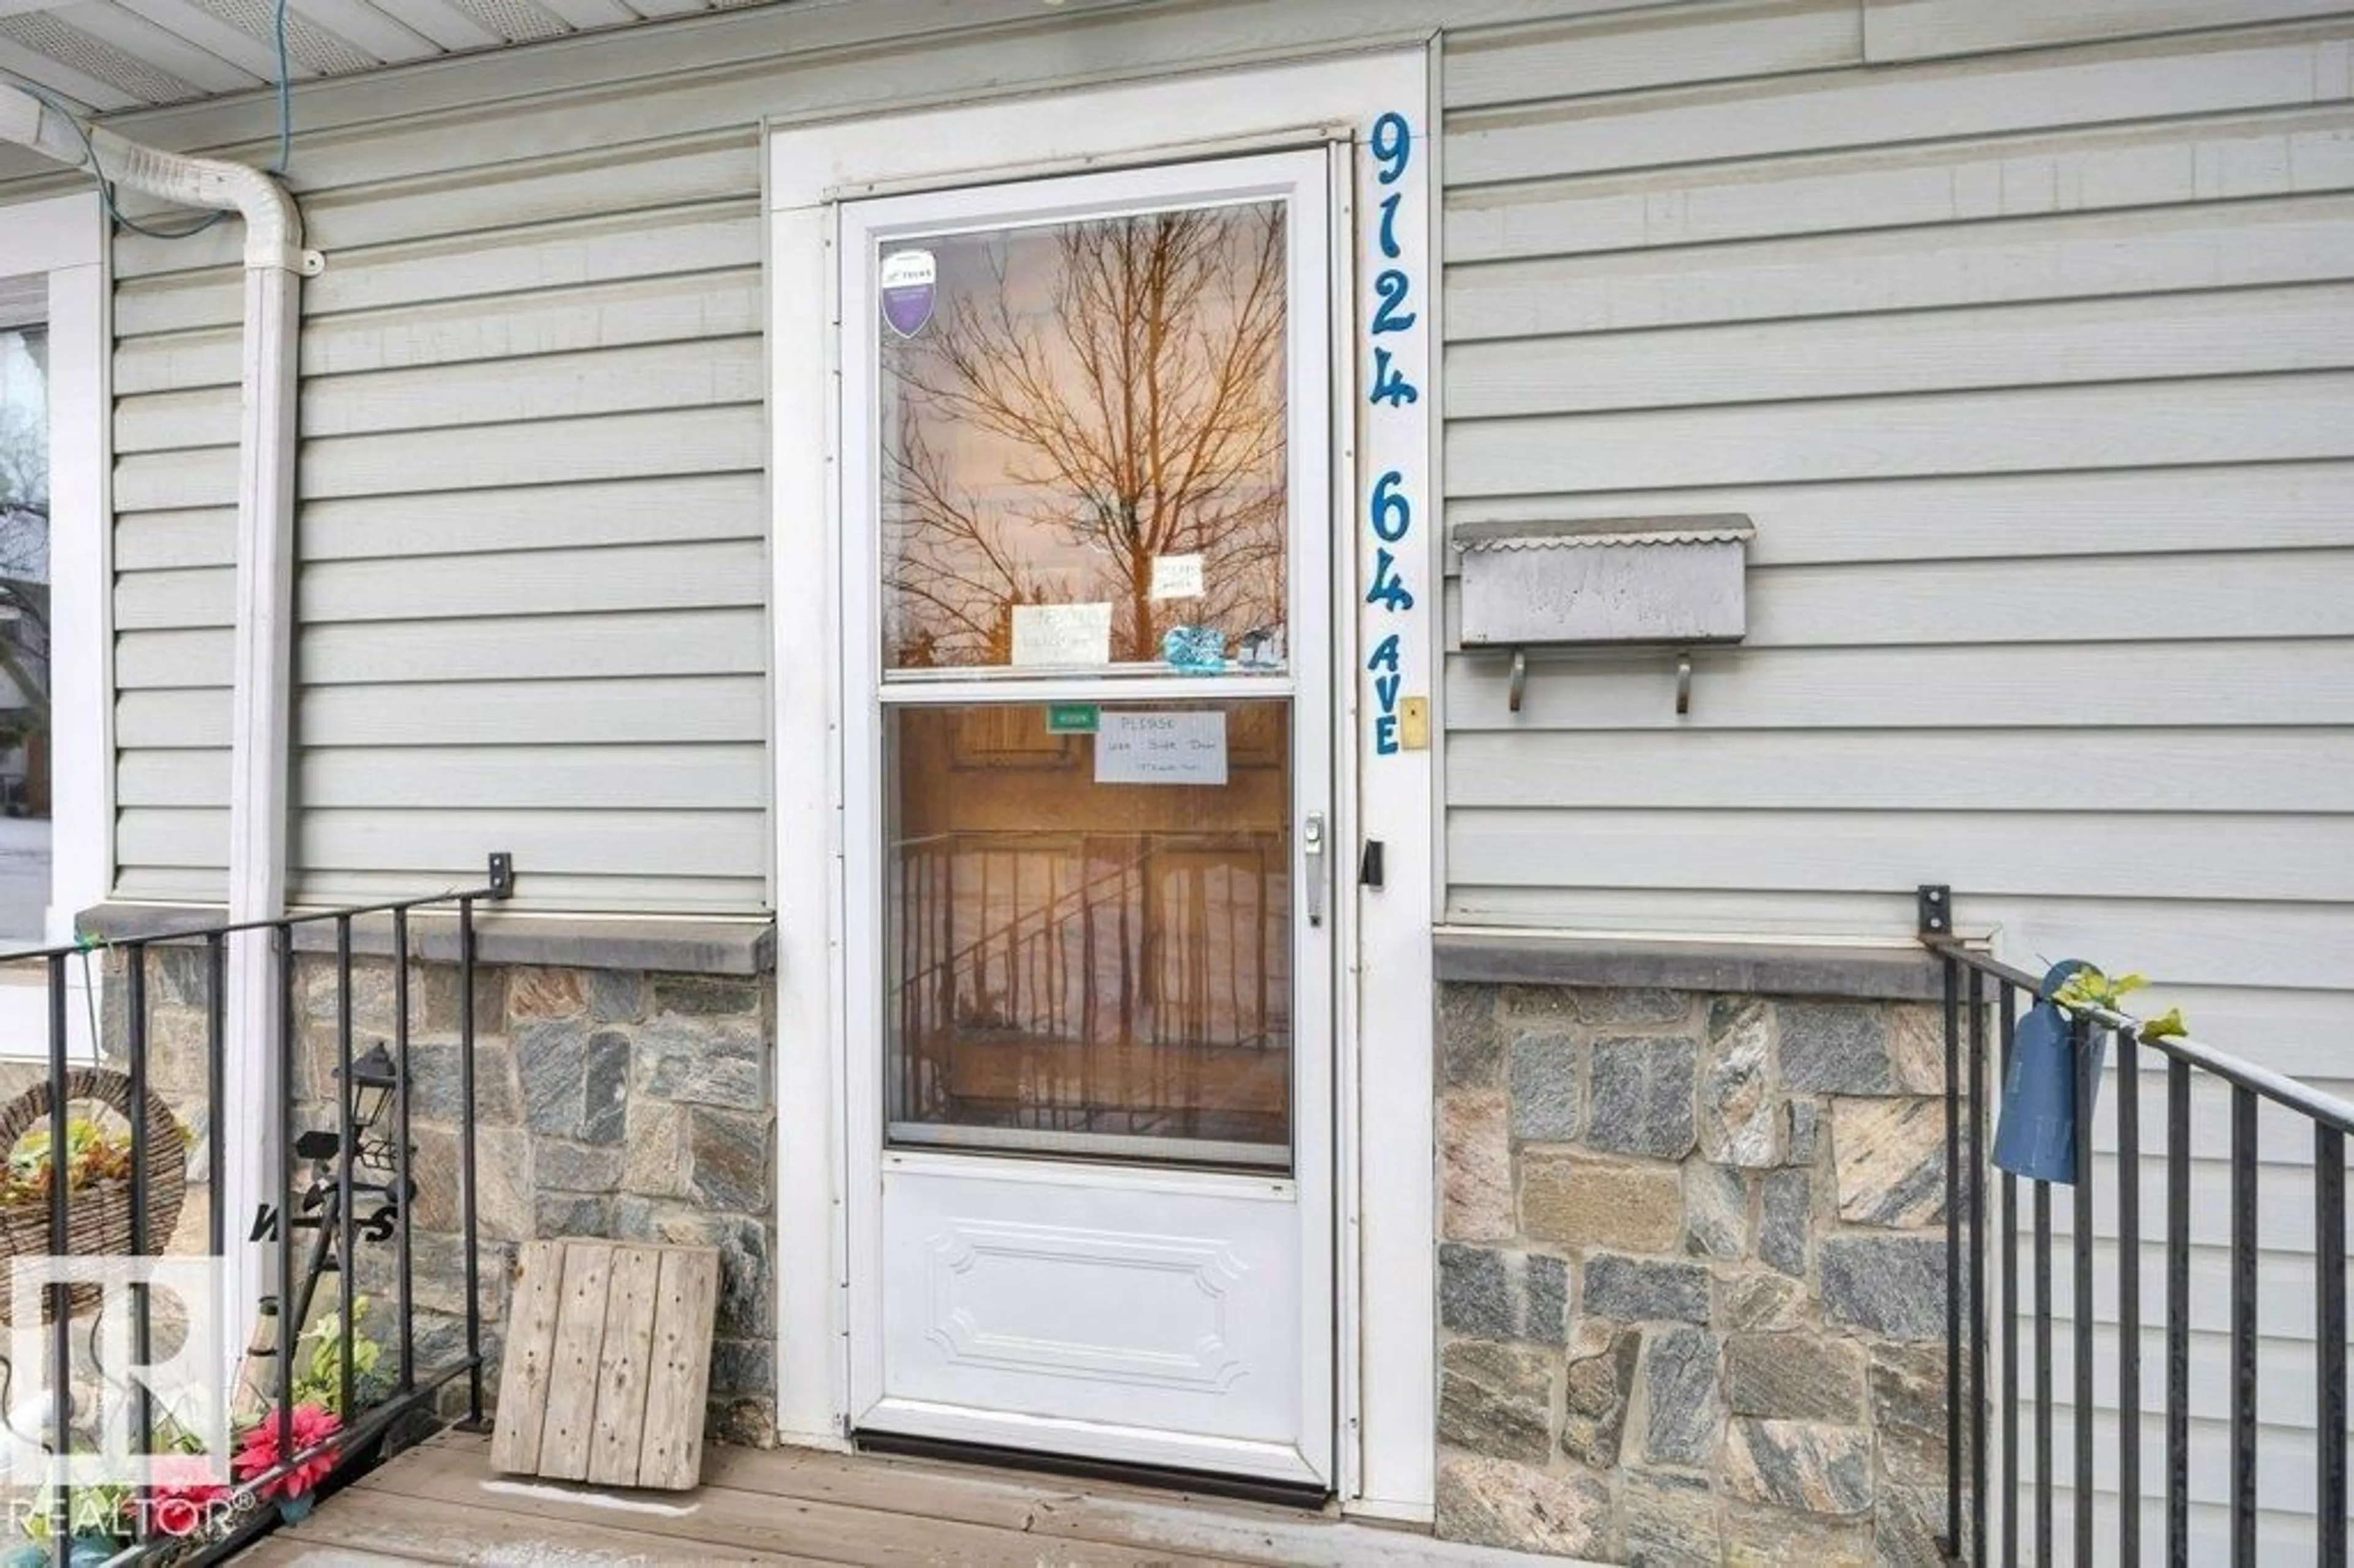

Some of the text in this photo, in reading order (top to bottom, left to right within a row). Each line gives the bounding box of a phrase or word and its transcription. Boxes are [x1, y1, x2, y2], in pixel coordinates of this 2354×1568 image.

[1365, 112, 1418, 756] 9124 64 AVE
